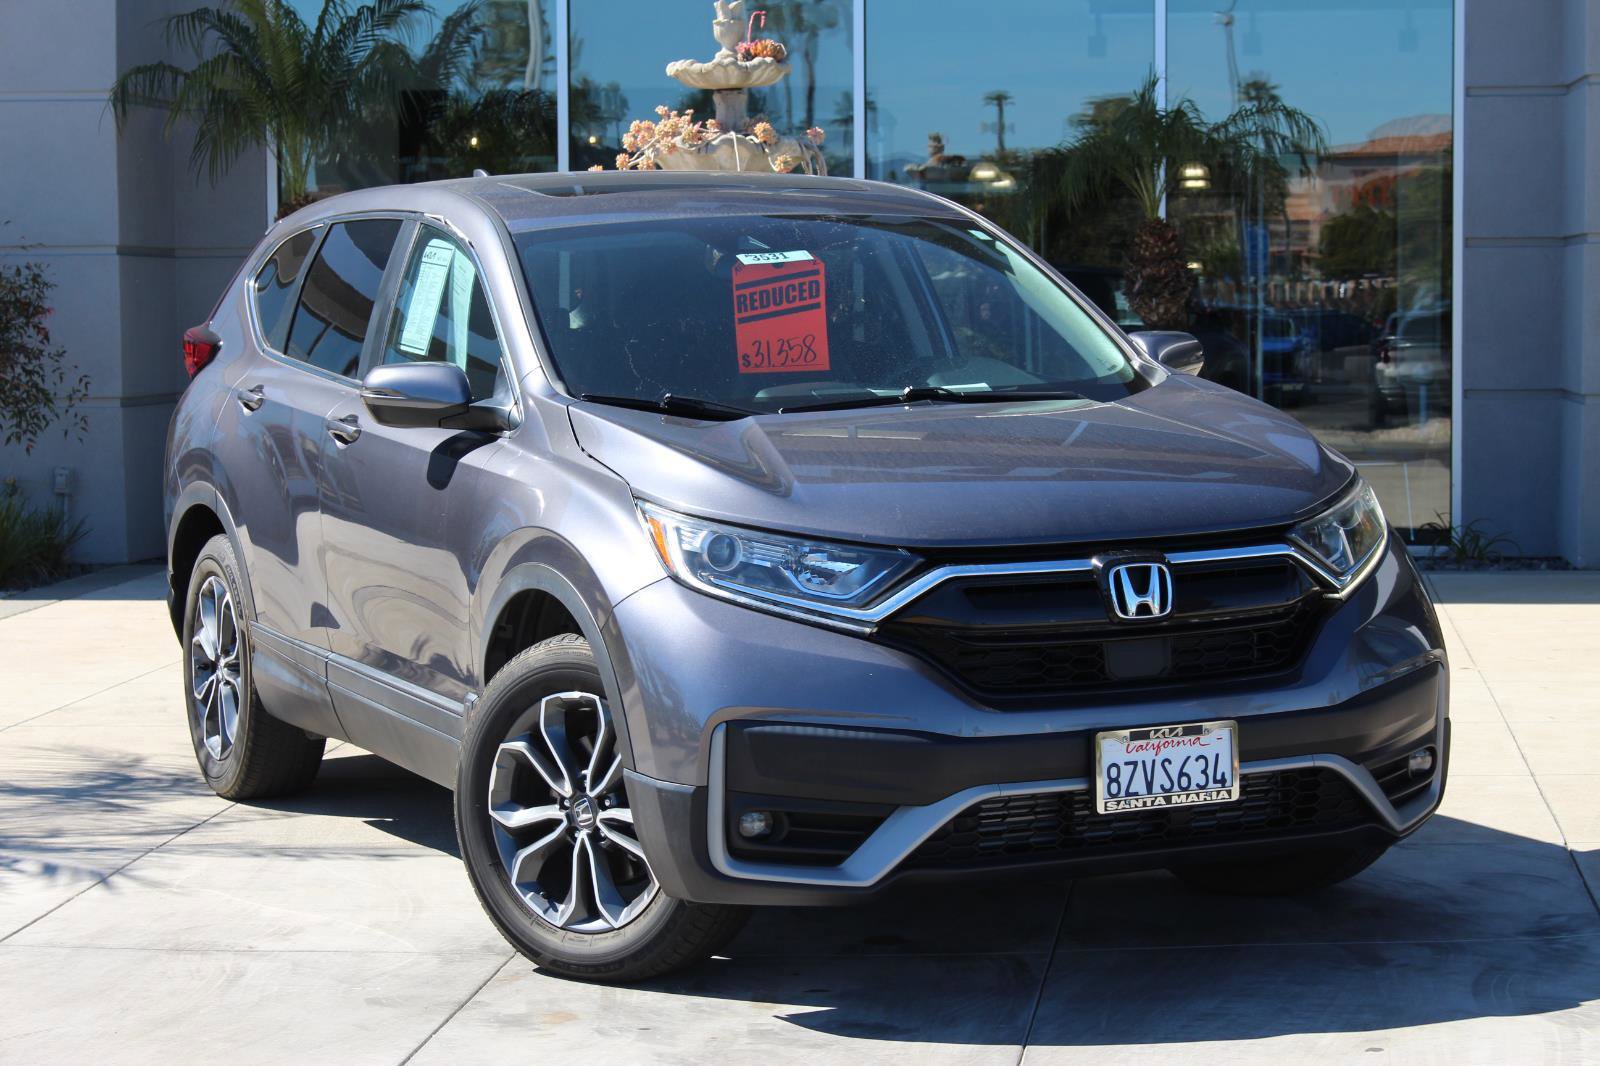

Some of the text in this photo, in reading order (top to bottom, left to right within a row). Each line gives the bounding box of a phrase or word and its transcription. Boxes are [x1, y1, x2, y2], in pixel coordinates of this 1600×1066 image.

[736, 279, 820, 314] REDUCED
[1125, 736, 1210, 756] California
[1106, 753, 1228, 798] 8ZVS634
[1106, 790, 1231, 811] SANTA MARIA
